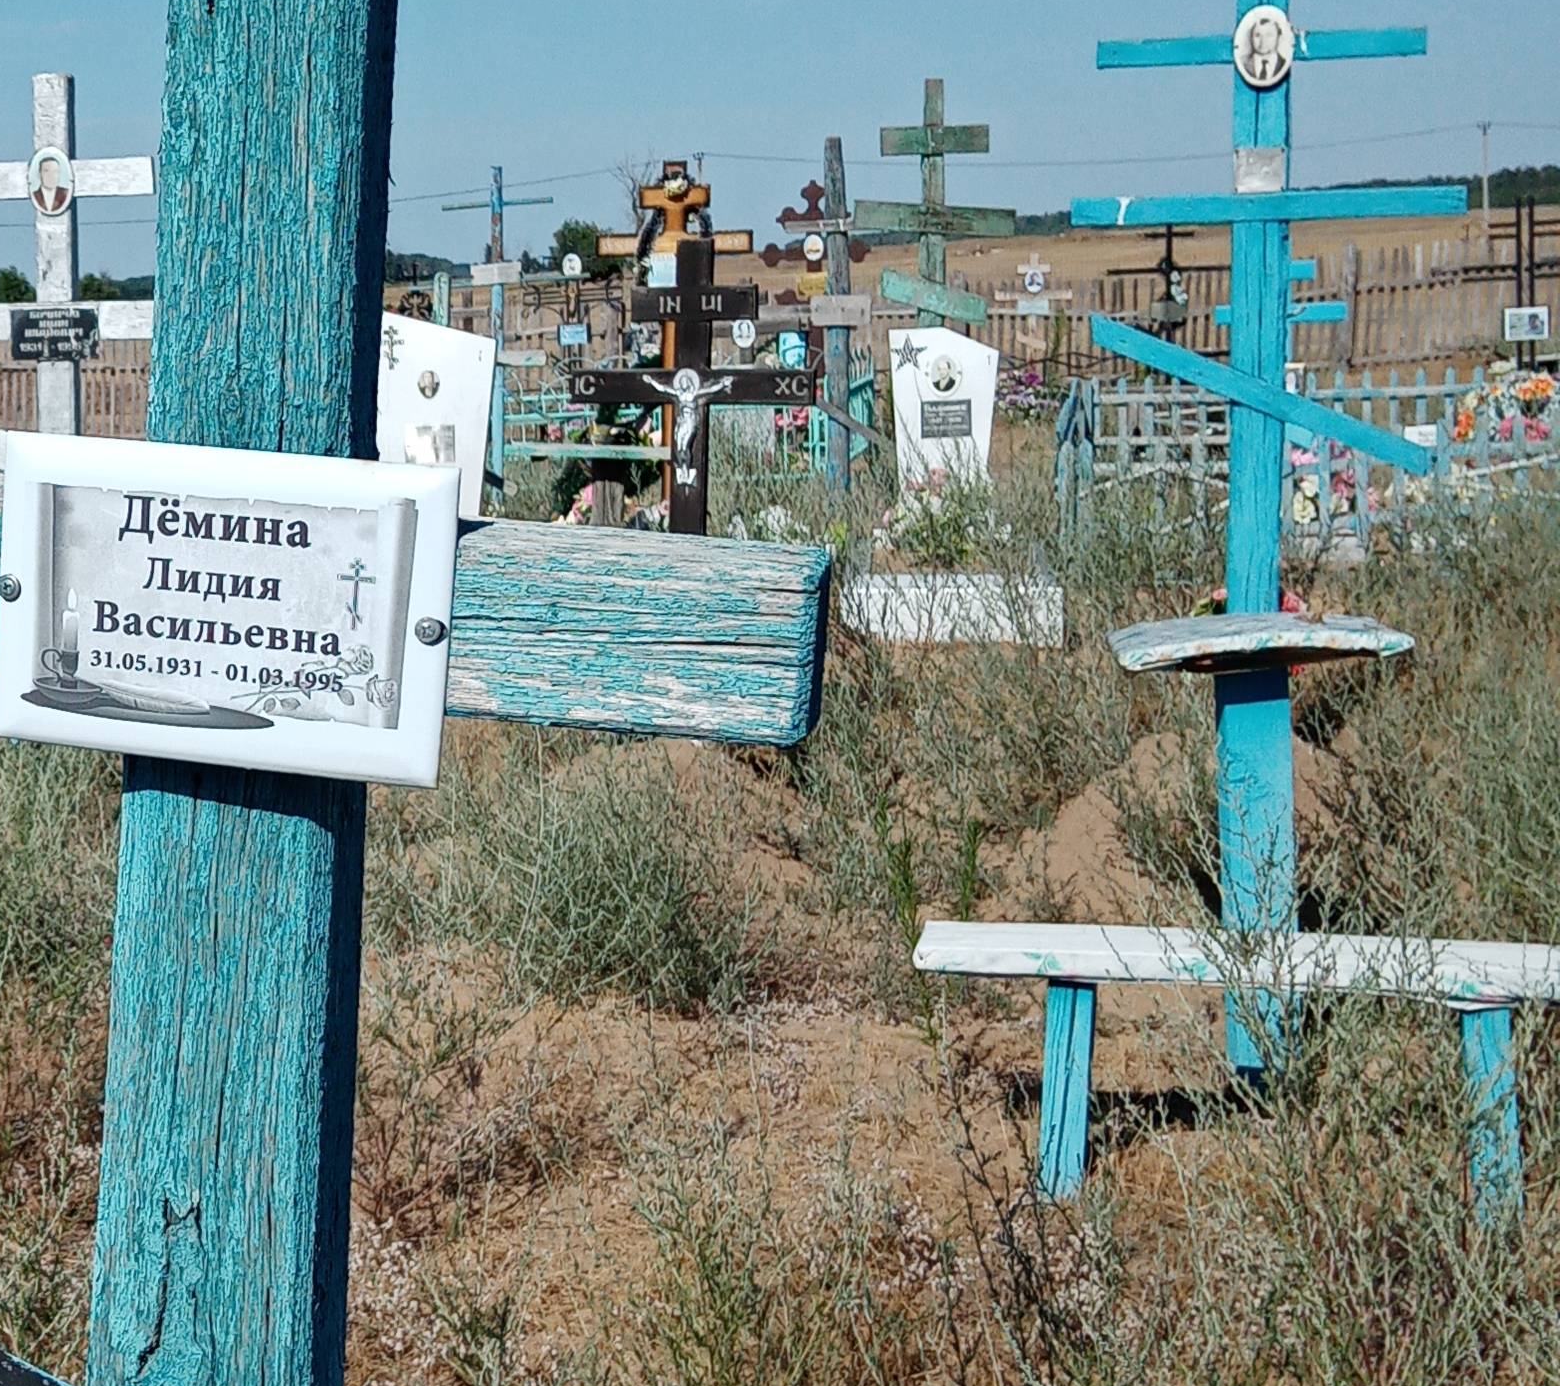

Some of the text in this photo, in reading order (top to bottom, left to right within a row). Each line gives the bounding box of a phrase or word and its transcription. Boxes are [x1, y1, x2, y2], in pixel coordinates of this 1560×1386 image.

[118, 494, 311, 549] Дёмина
[143, 557, 282, 603] Лидия
[92, 601, 342, 657] Васильевна
[90, 649, 202, 677] 31.05.1931
[225, 664, 344, 692] 01.03.1995
